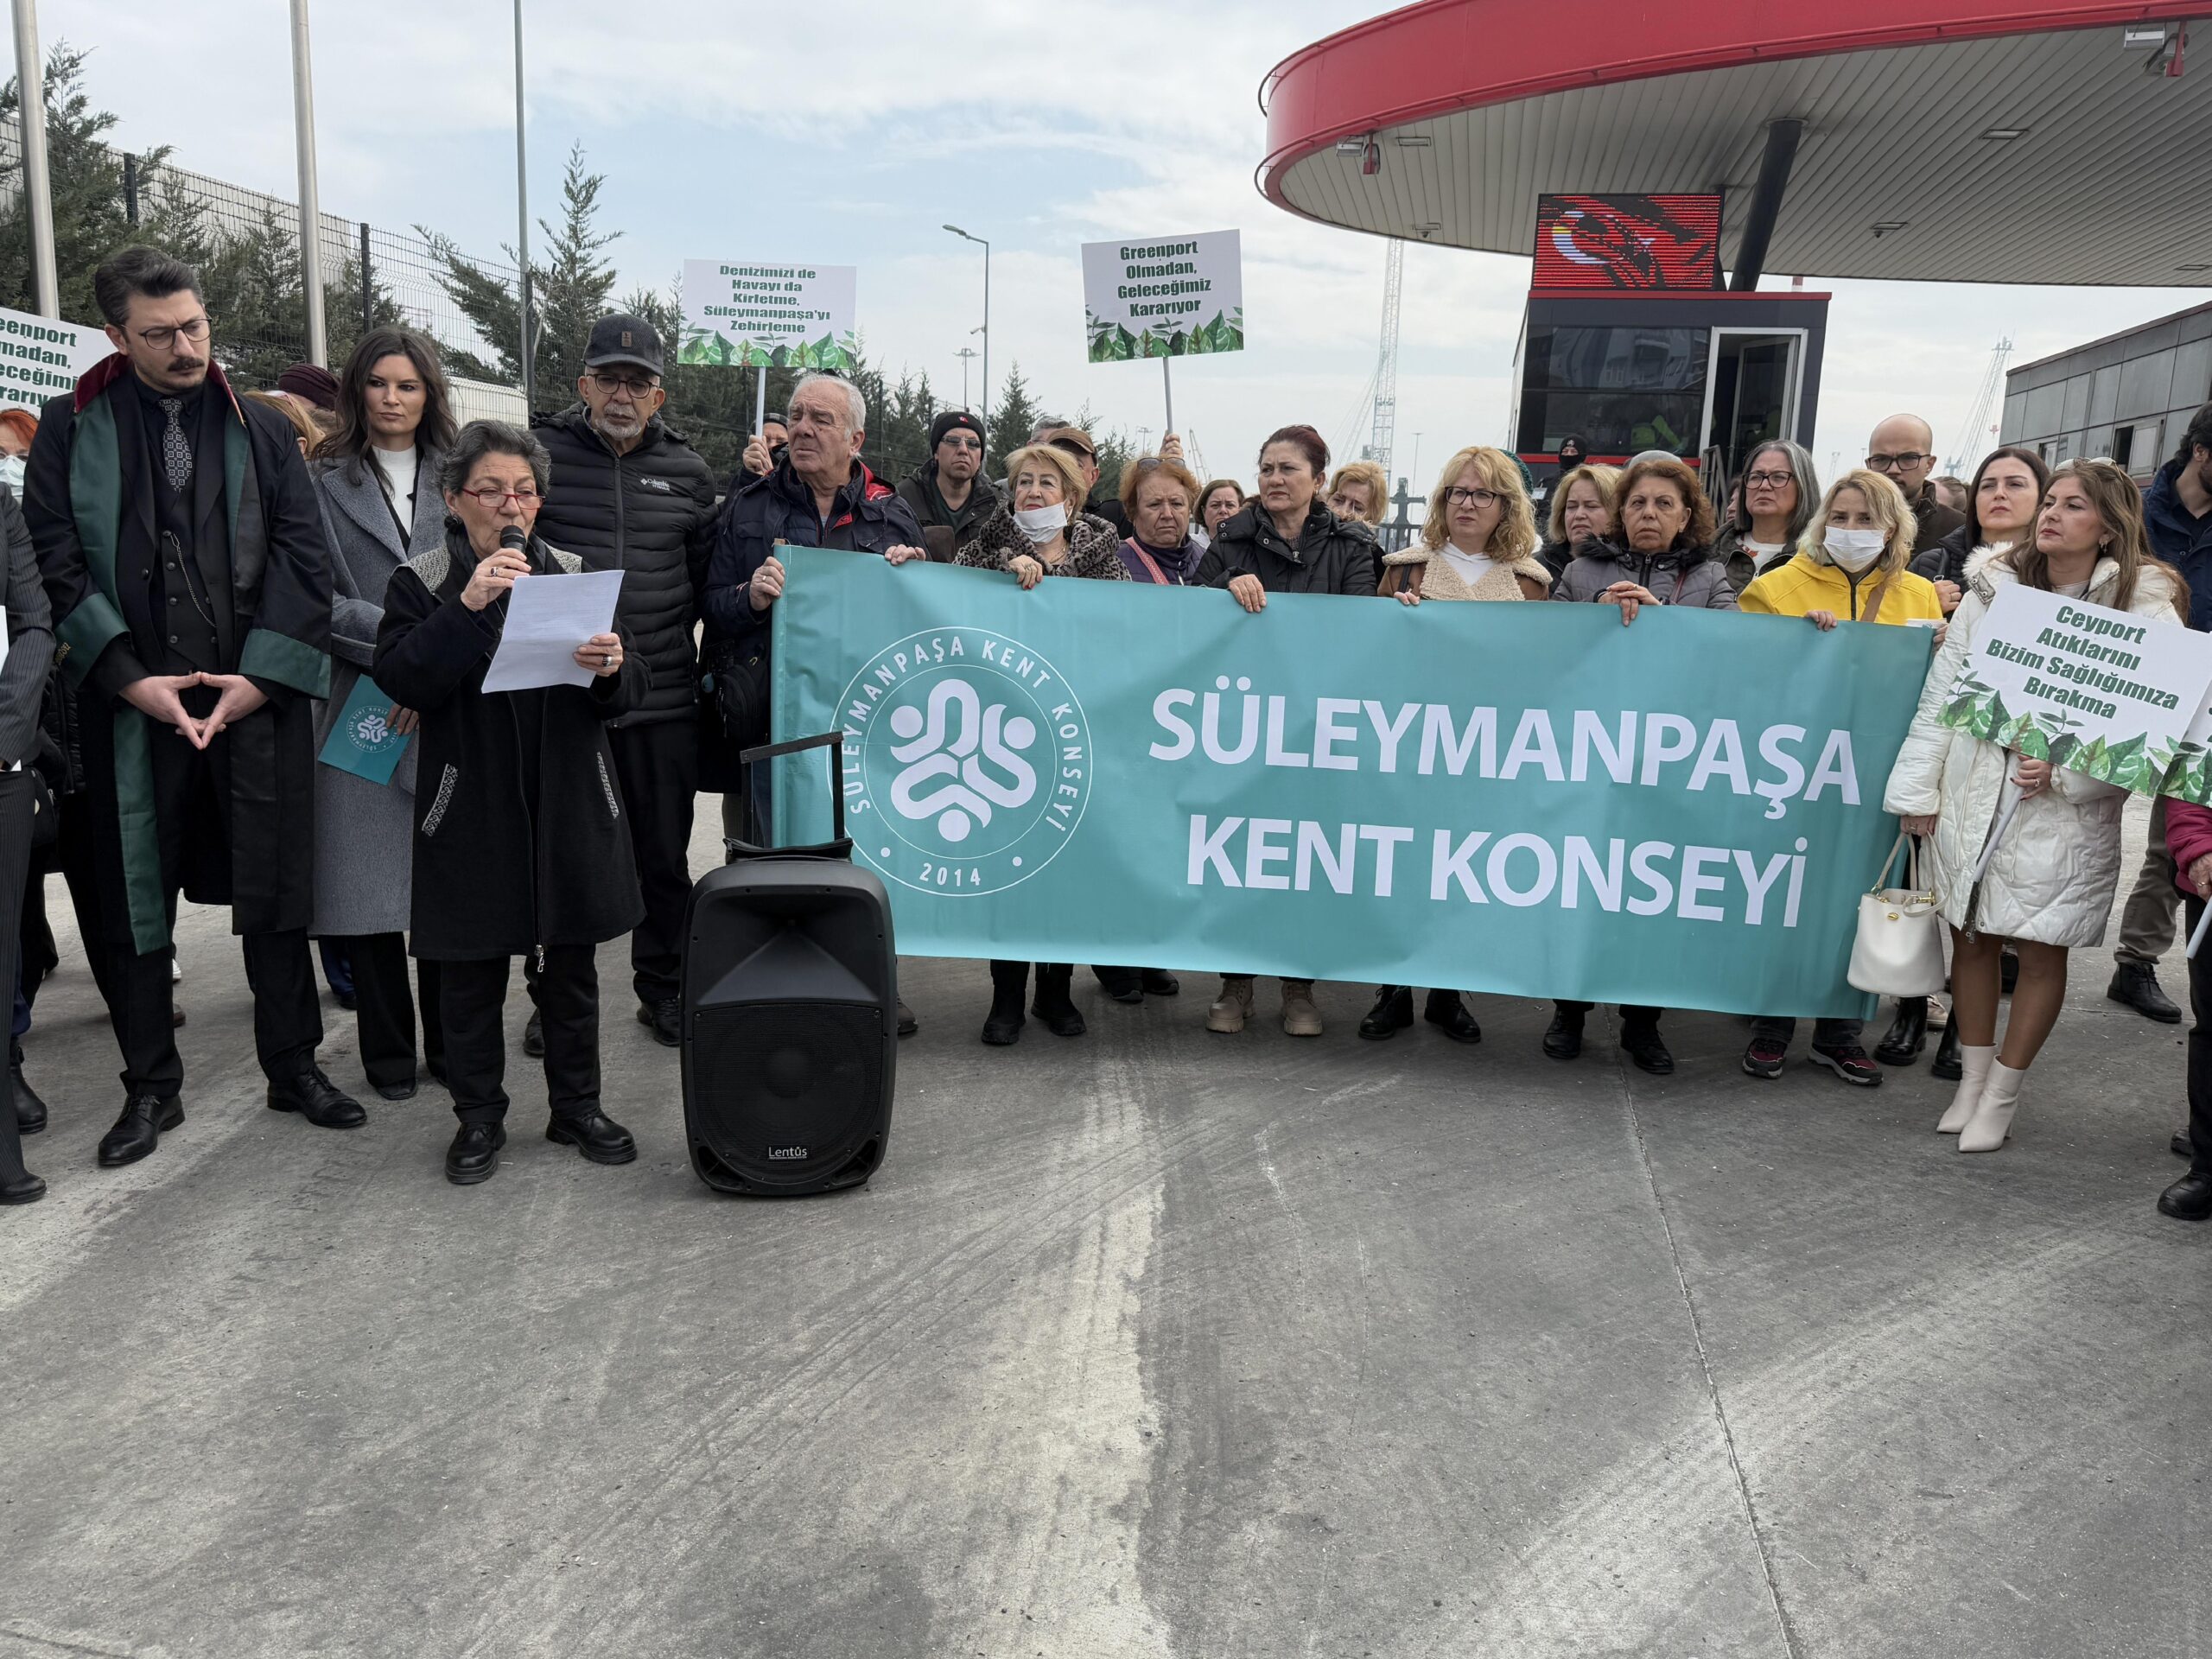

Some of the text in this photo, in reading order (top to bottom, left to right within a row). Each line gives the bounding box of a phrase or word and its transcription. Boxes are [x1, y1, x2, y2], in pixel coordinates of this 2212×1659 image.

[1121, 241, 1198, 260] Greenport
[720, 265, 817, 279] Denizimizi de
[1126, 262, 1197, 279] Olmadan,
[732, 279, 803, 292] Havayı da
[1117, 278, 1211, 299] Geleceğimiz
[704, 305, 830, 321] Süleymanpaşa'yı
[1130, 300, 1201, 317] Kararıyor
[730, 321, 806, 333] Zehirleme
[2056, 605, 2147, 645] Ceyport
[2036, 627, 2142, 671] Atıklarını
[1986, 639, 2179, 710] Bizim Sağlığımıza
[2023, 676, 2117, 719] Bırakma
[982, 639, 1051, 688] KENT
[1046, 702, 1083, 831] KONSEYİ
[1148, 676, 1860, 820] SÜLEYMANPAŞA
[919, 862, 981, 887] 2014
[1187, 815, 1808, 928] KENT KONSEYİ
